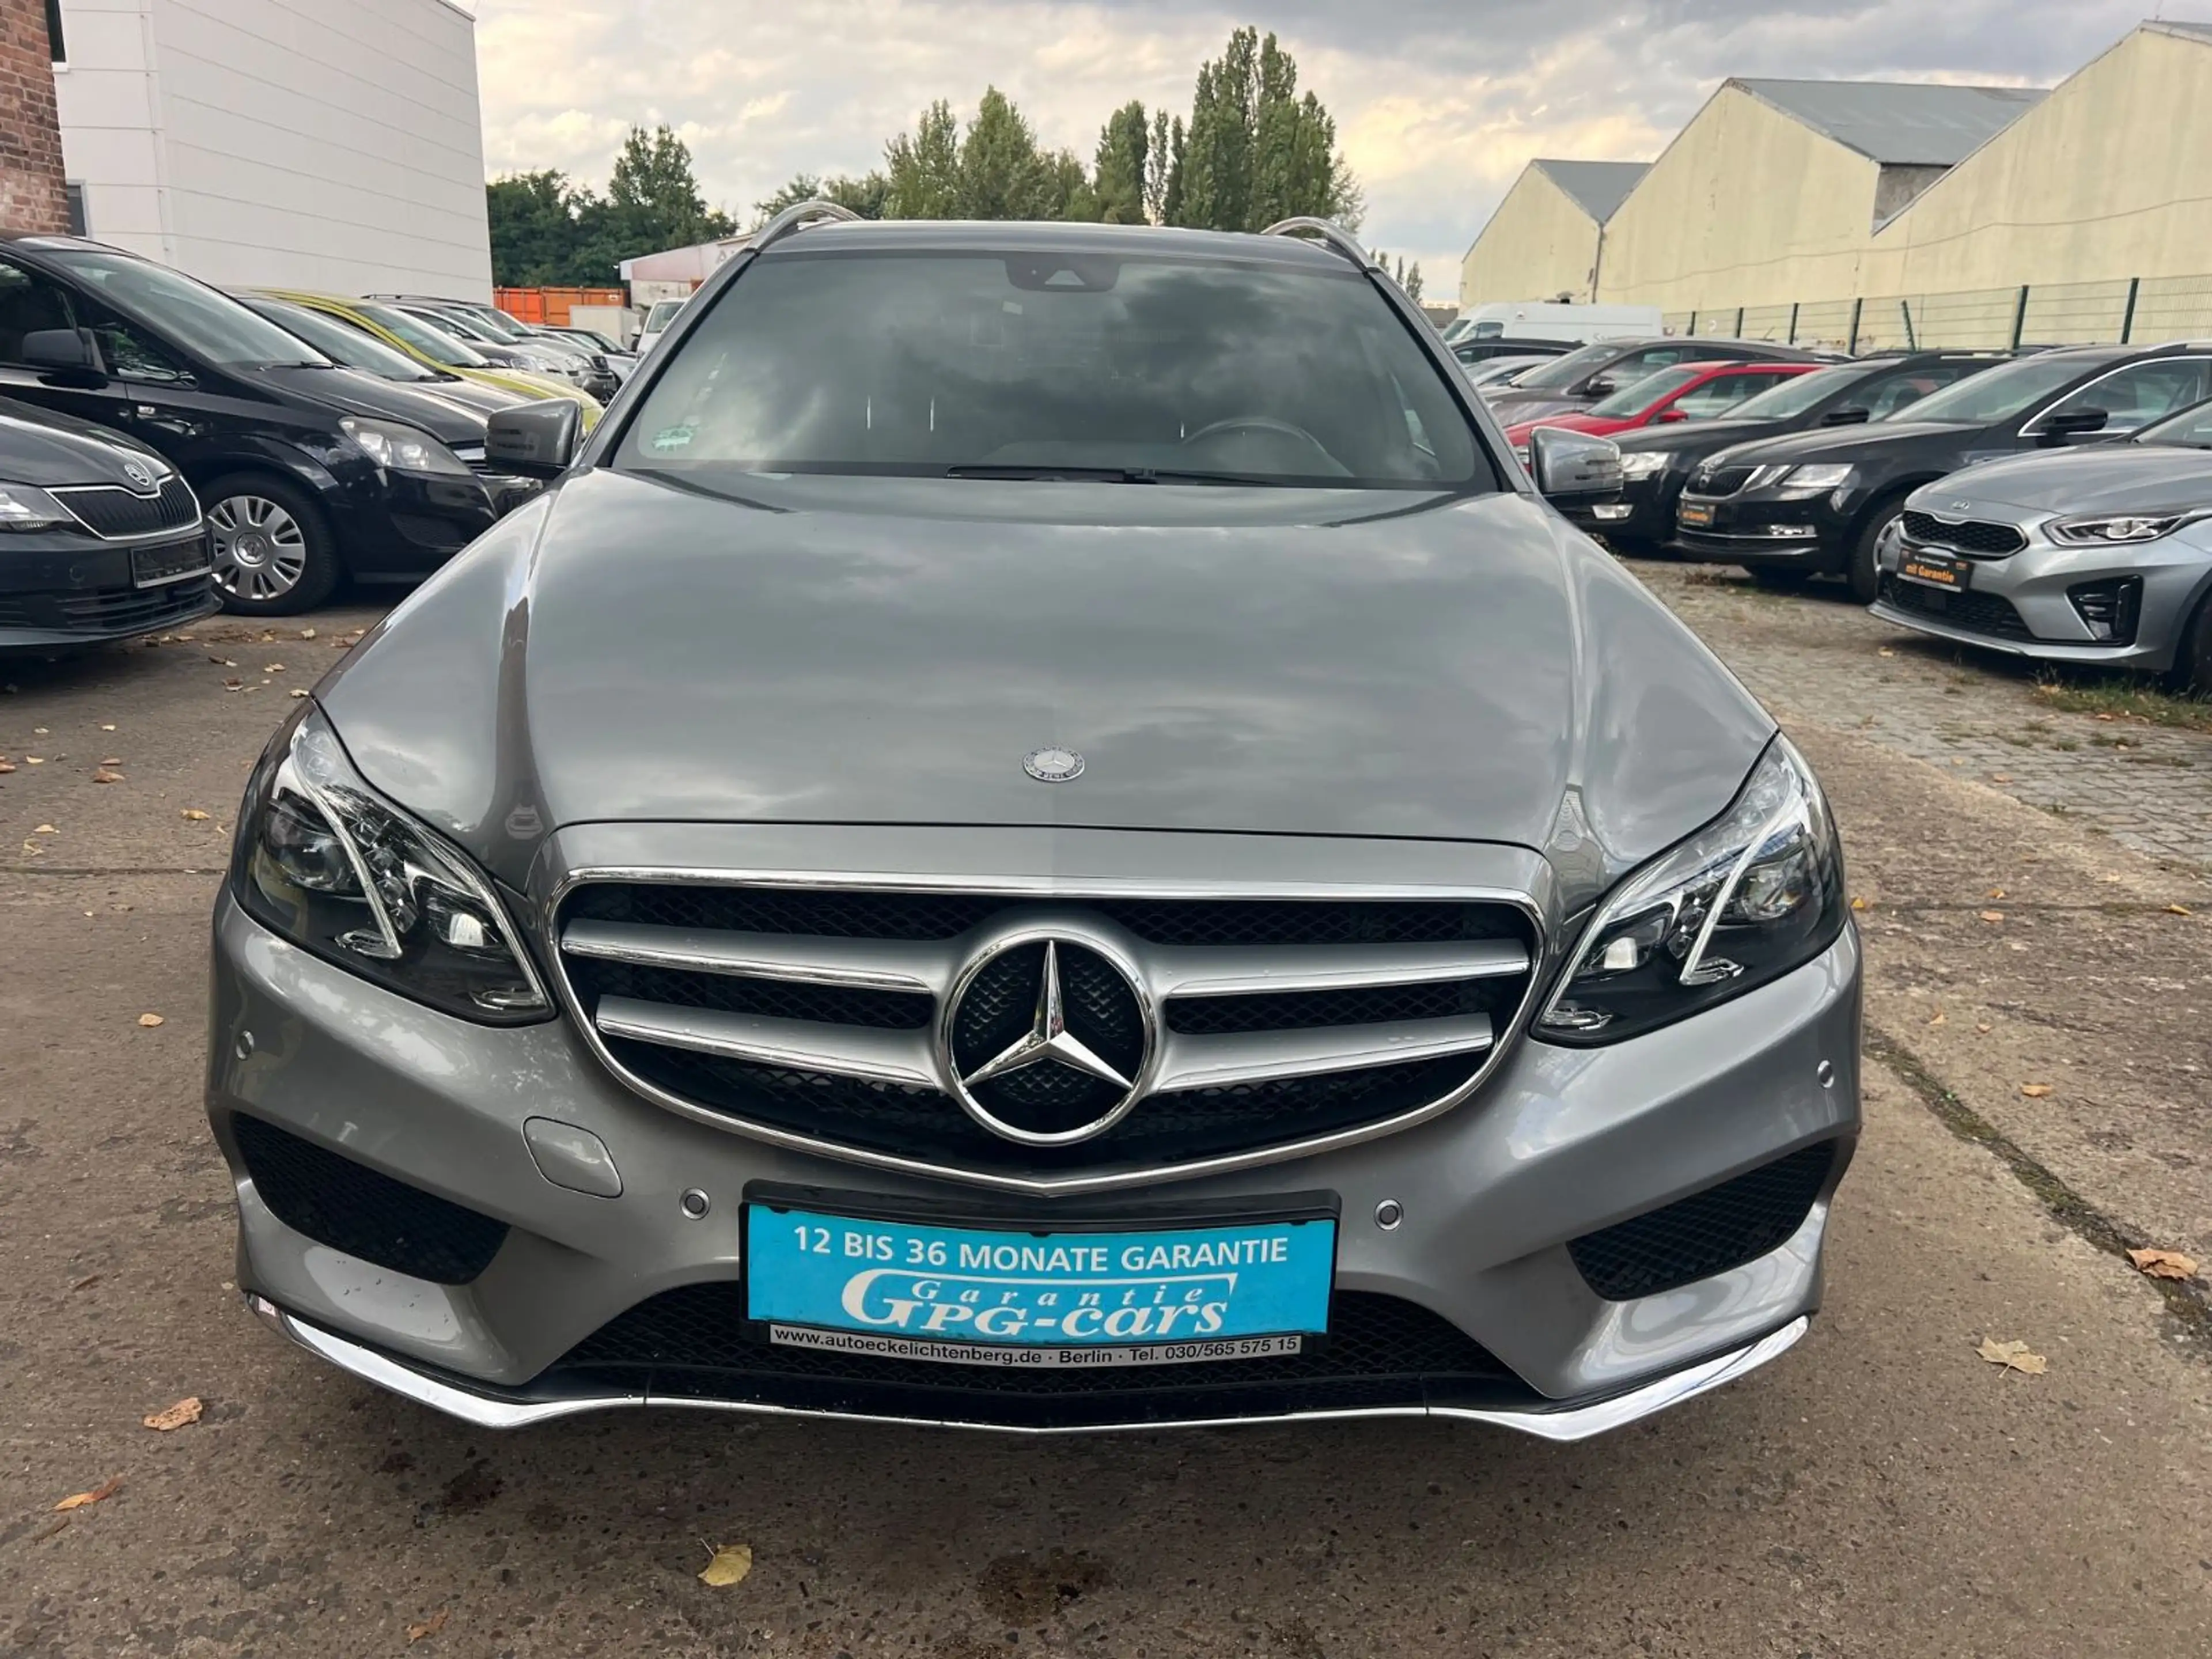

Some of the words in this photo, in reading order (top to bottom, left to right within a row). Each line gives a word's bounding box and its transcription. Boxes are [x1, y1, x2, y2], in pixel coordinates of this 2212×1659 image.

[794, 1226, 831, 1253] 12
[844, 1232, 893, 1260] BIS
[906, 1238, 946, 1266] 36
[960, 1244, 1108, 1272] MONATE
[1121, 1237, 1288, 1271] GARANTIE
[911, 1280, 1203, 1305] Garantie
[774, 1328, 1041, 1365] www.autoeckelichtenberg.de
[1059, 1350, 1112, 1363] Berlin
[1130, 1349, 1159, 1361] Tel.
[1165, 1341, 1236, 1360] 030/565
[1240, 1339, 1271, 1354] 575
[1278, 1337, 1297, 1350] 15
